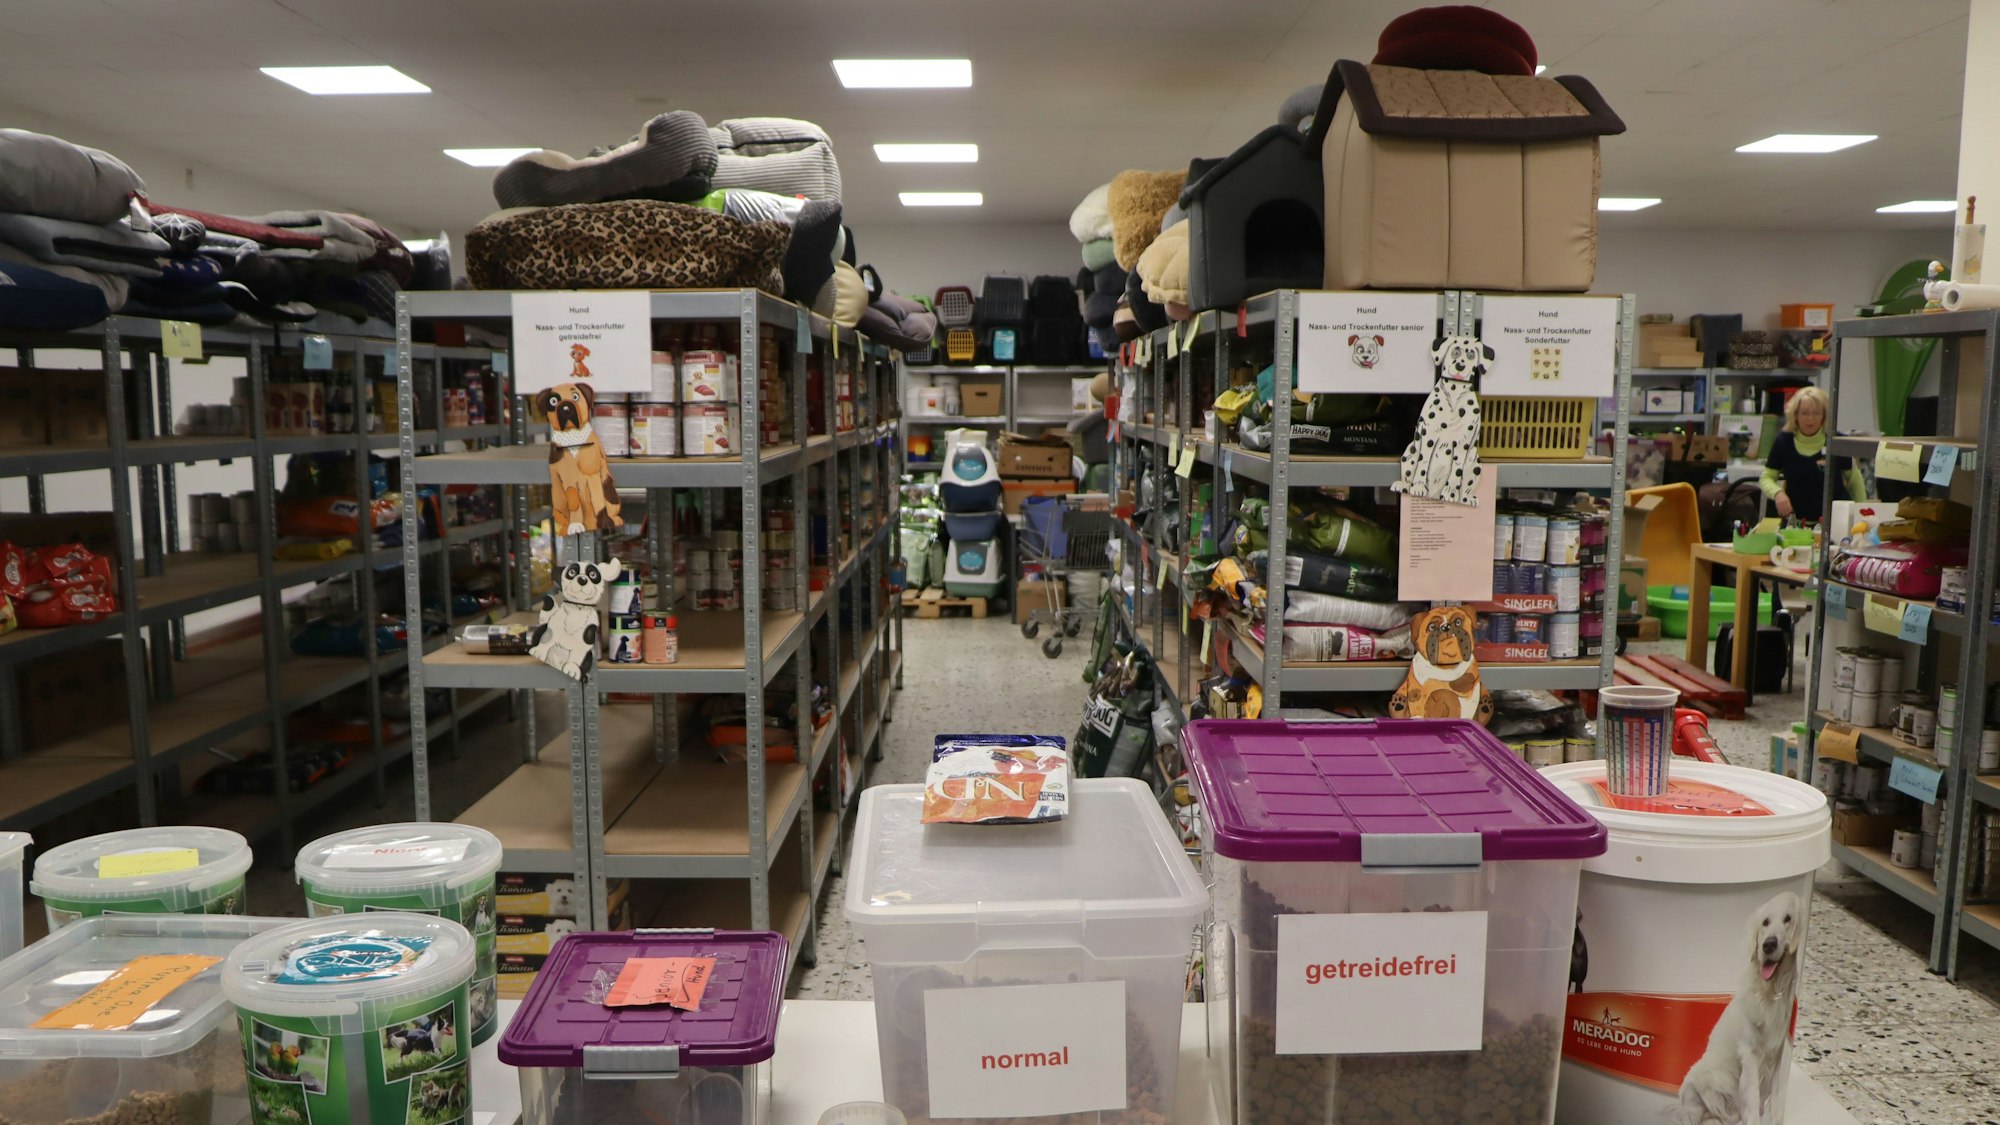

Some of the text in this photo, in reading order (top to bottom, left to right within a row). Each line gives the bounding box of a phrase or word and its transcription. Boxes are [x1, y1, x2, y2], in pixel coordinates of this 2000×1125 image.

[1356, 306, 1377, 314] Hund
[574, 322, 625, 330] Trockenfutter
[1348, 323, 1398, 331] Trockenfutter
[1503, 326, 1525, 334] Nass-
[1543, 327, 1592, 335] Trockenfutter
[558, 332, 602, 341] getreidefrei
[1524, 336, 1570, 344] Sonderfutter
[1292, 424, 1329, 438] HAPPY DOG
[1343, 436, 1378, 444] MONTANA
[1305, 954, 1457, 985] getreidefrei
[1573, 1018, 1650, 1048] MERADOG
[1577, 1036, 1642, 1057] ES LEBE DER HUND
[981, 1046, 1069, 1070] normal
